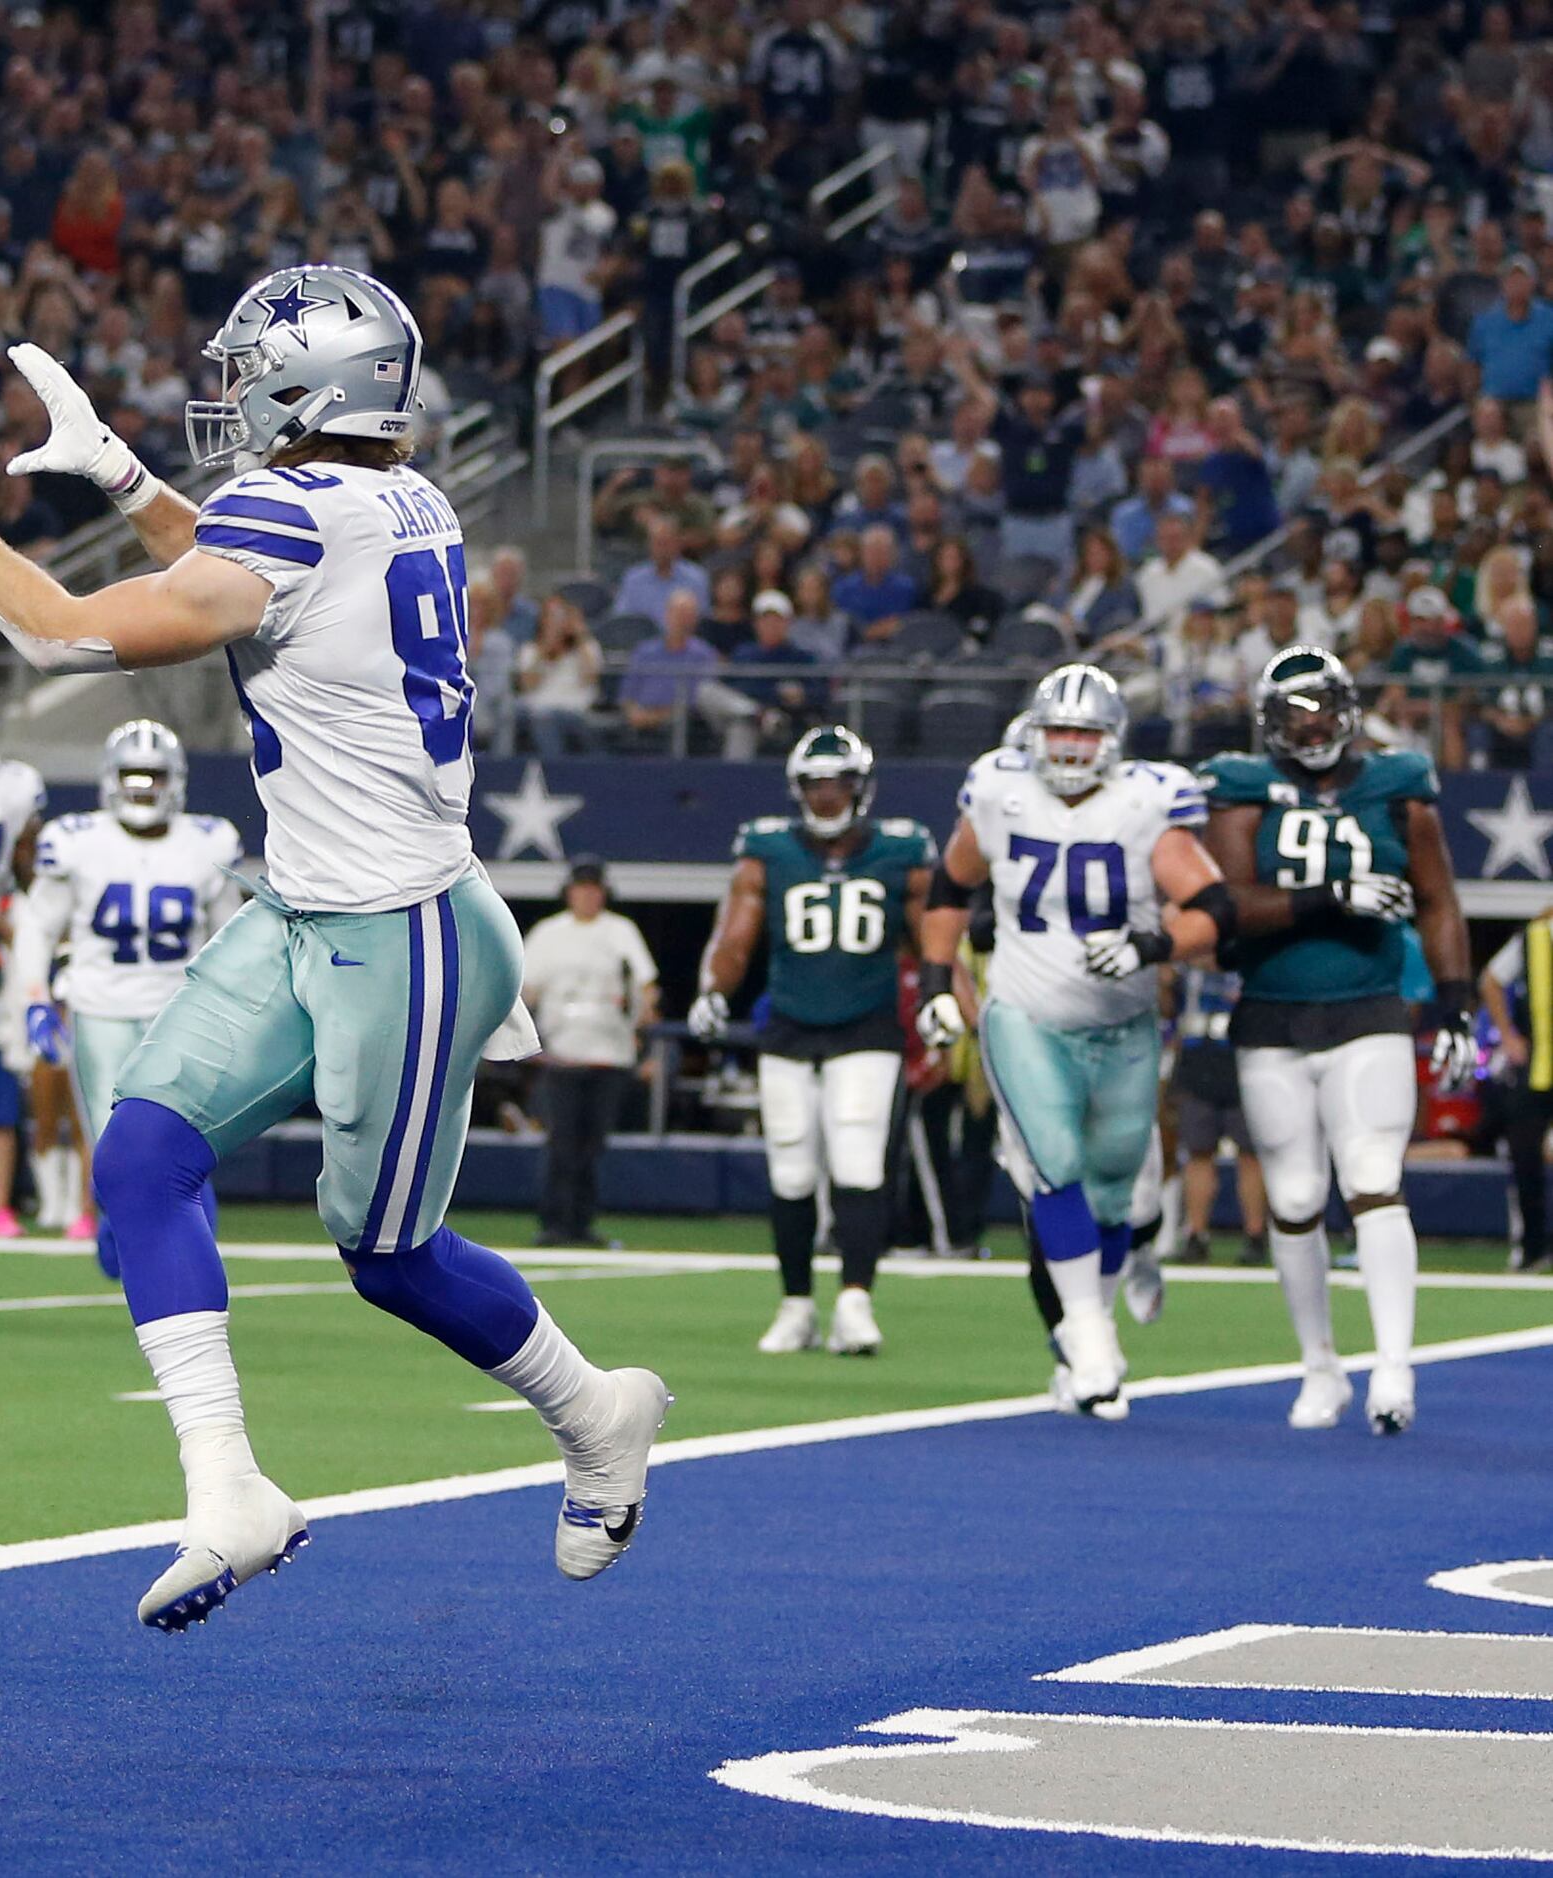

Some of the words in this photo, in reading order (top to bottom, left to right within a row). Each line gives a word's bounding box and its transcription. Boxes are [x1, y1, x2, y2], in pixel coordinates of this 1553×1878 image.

[1009, 834, 1128, 938] 70
[1276, 808, 1372, 889] 91
[91, 883, 195, 963] 48
[784, 878, 887, 955] 66
